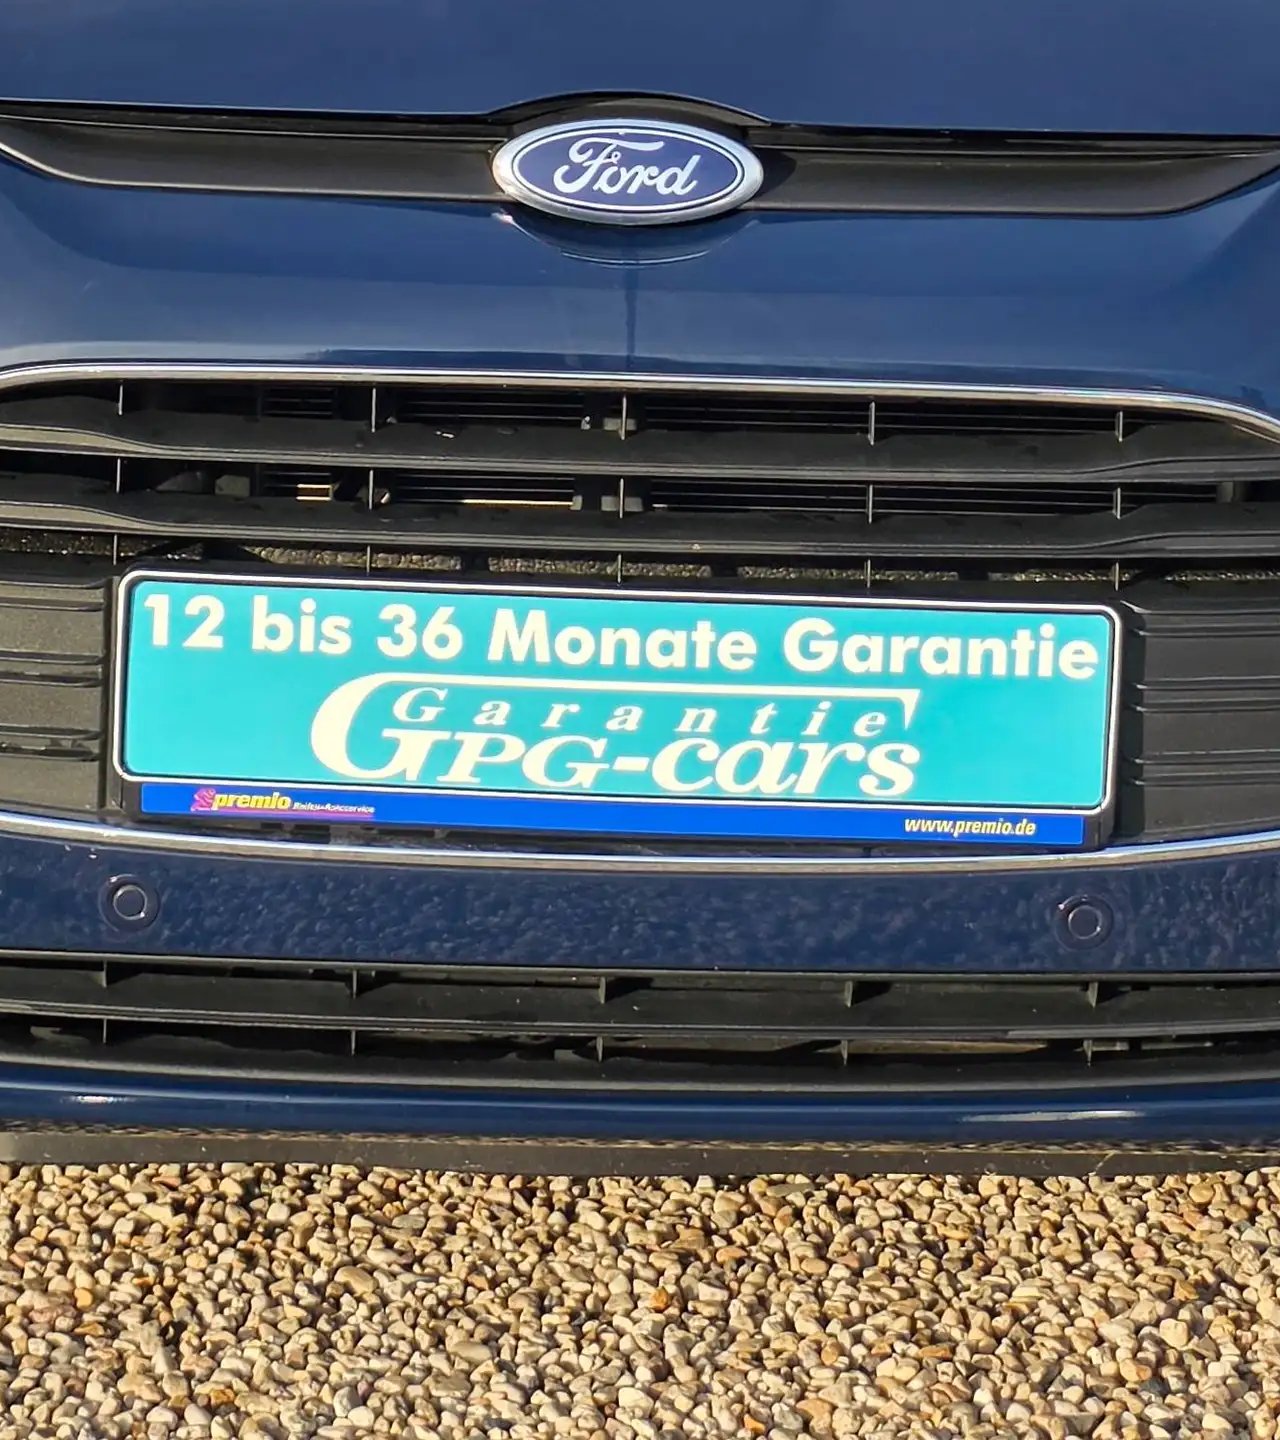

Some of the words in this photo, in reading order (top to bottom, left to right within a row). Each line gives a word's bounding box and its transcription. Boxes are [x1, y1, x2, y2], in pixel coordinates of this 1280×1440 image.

[553, 137, 701, 196] Ford
[144, 593, 225, 648] 12
[251, 594, 352, 654] bis
[376, 603, 463, 660] 36
[487, 608, 757, 670] Monate
[784, 618, 1098, 678] Garantie
[393, 687, 887, 737] Garantie
[212, 792, 291, 810] premio
[904, 817, 1037, 837] www.premio.de
